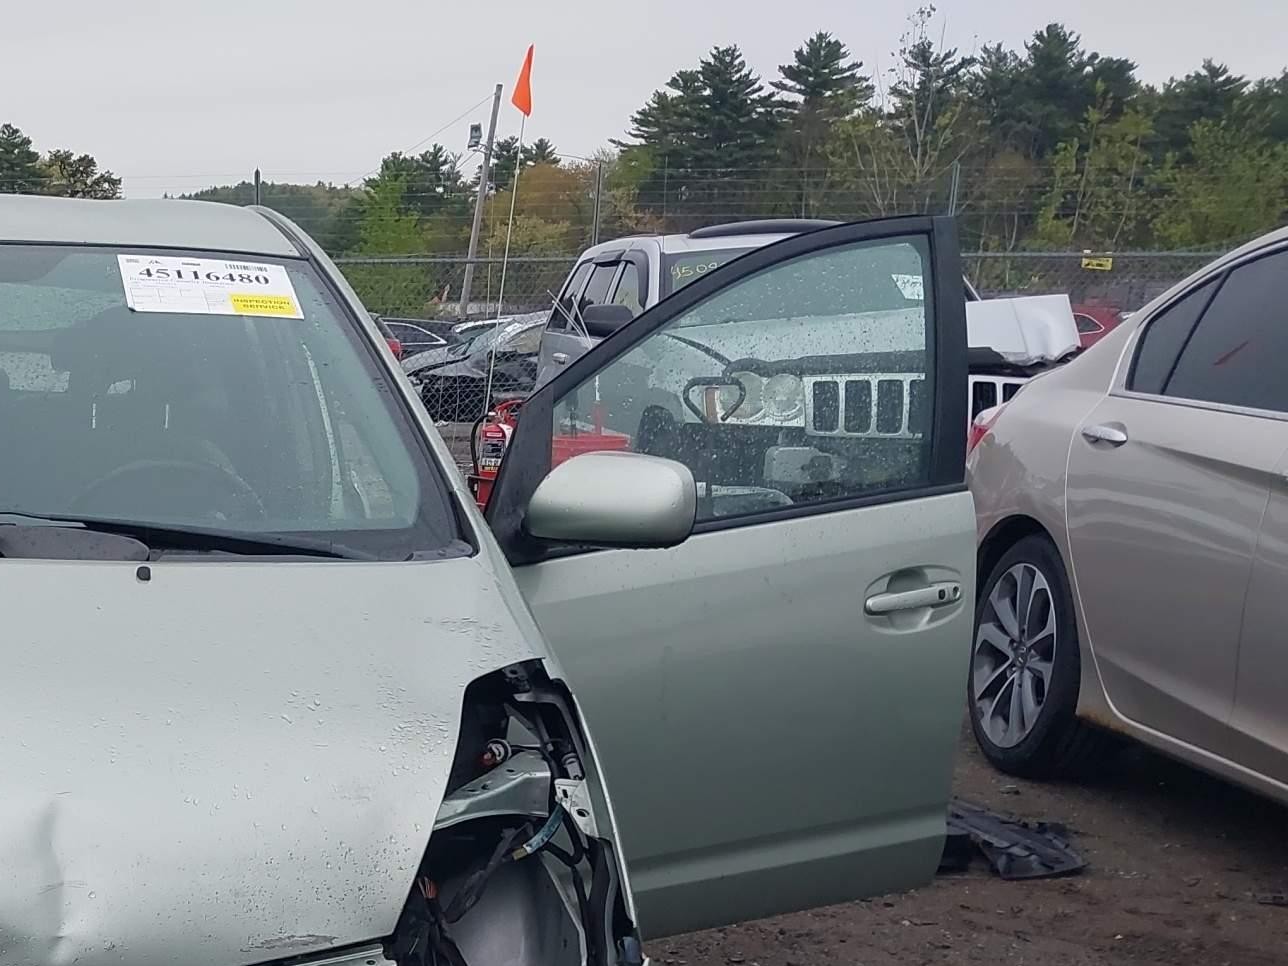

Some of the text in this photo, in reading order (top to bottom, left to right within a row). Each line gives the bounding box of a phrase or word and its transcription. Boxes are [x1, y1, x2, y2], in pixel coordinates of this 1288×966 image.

[138, 267, 270, 285] 45116480
[233, 297, 290, 306] INSPECTION
[242, 303, 286, 311] SERVICE
